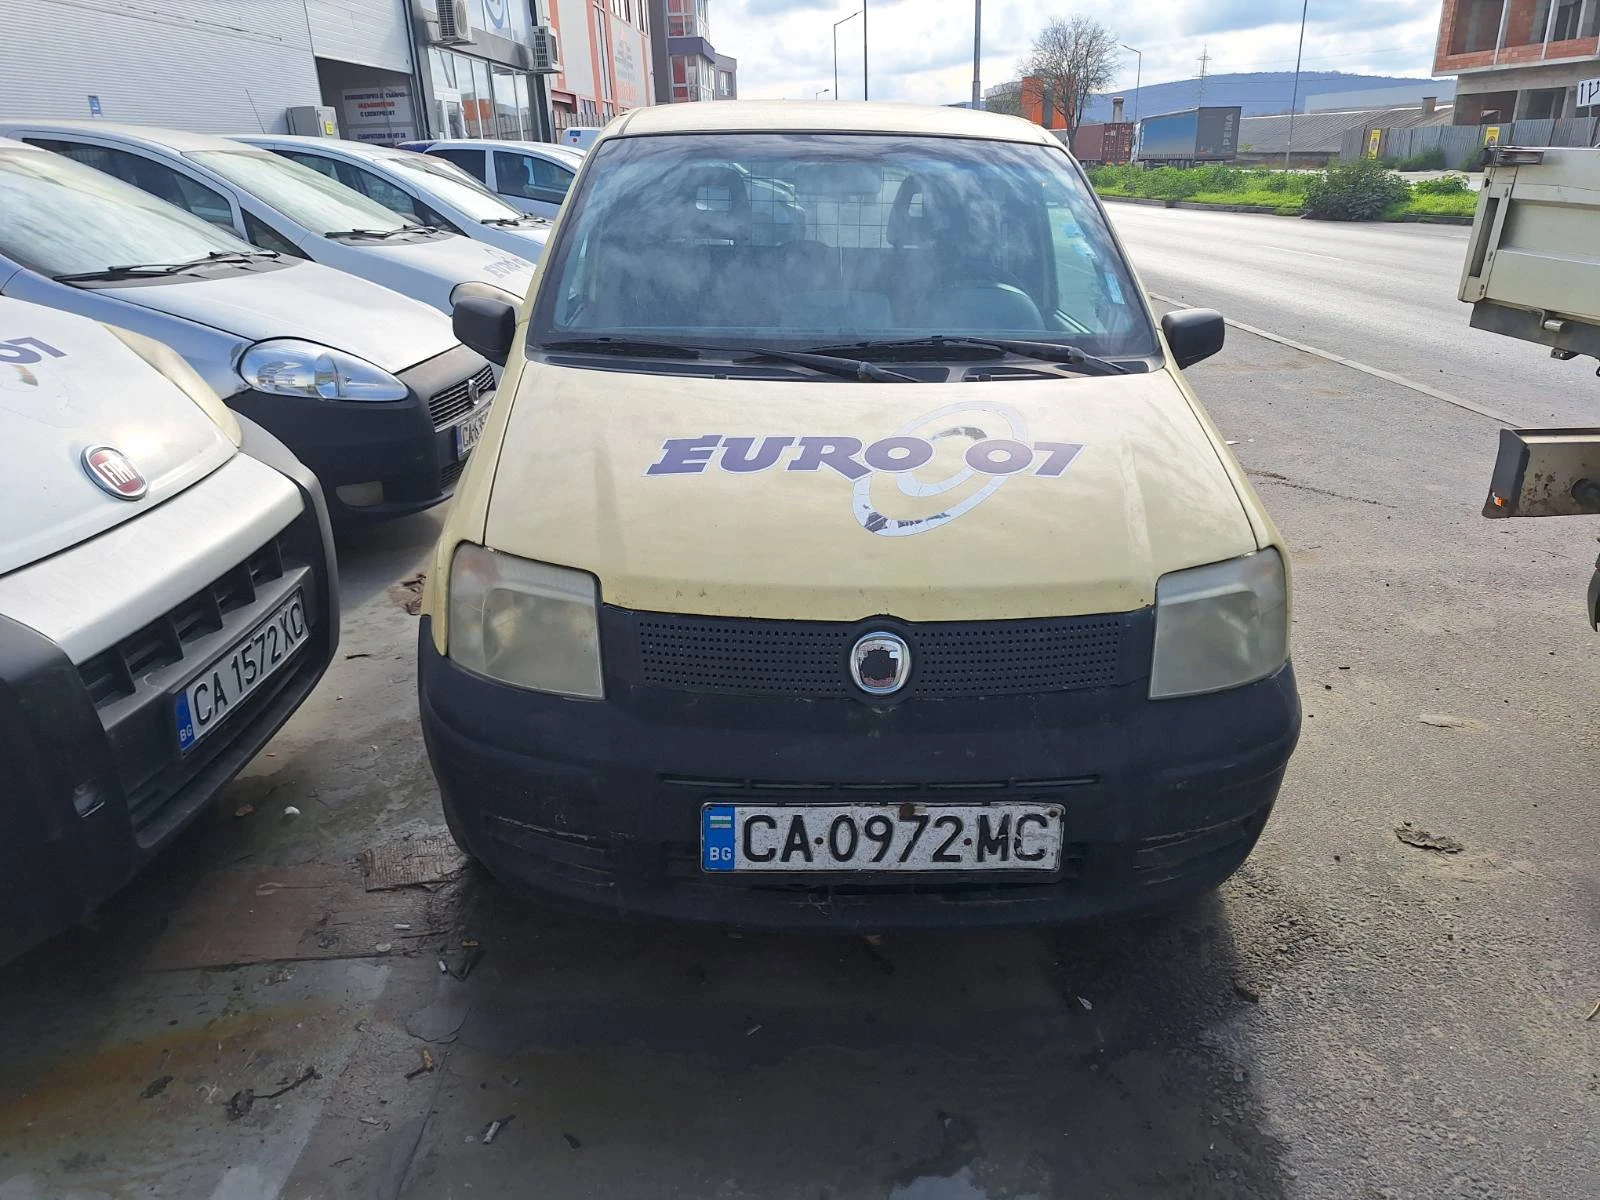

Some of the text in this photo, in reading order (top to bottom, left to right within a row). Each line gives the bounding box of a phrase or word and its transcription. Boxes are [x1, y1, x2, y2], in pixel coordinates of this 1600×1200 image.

[1223, 113, 1234, 146] PEMA
[645, 434, 1086, 481] EURO 07
[193, 671, 228, 726] CA
[180, 724, 193, 742] BG
[709, 846, 732, 861] BG
[742, 813, 1048, 863] CA 0972 MC
